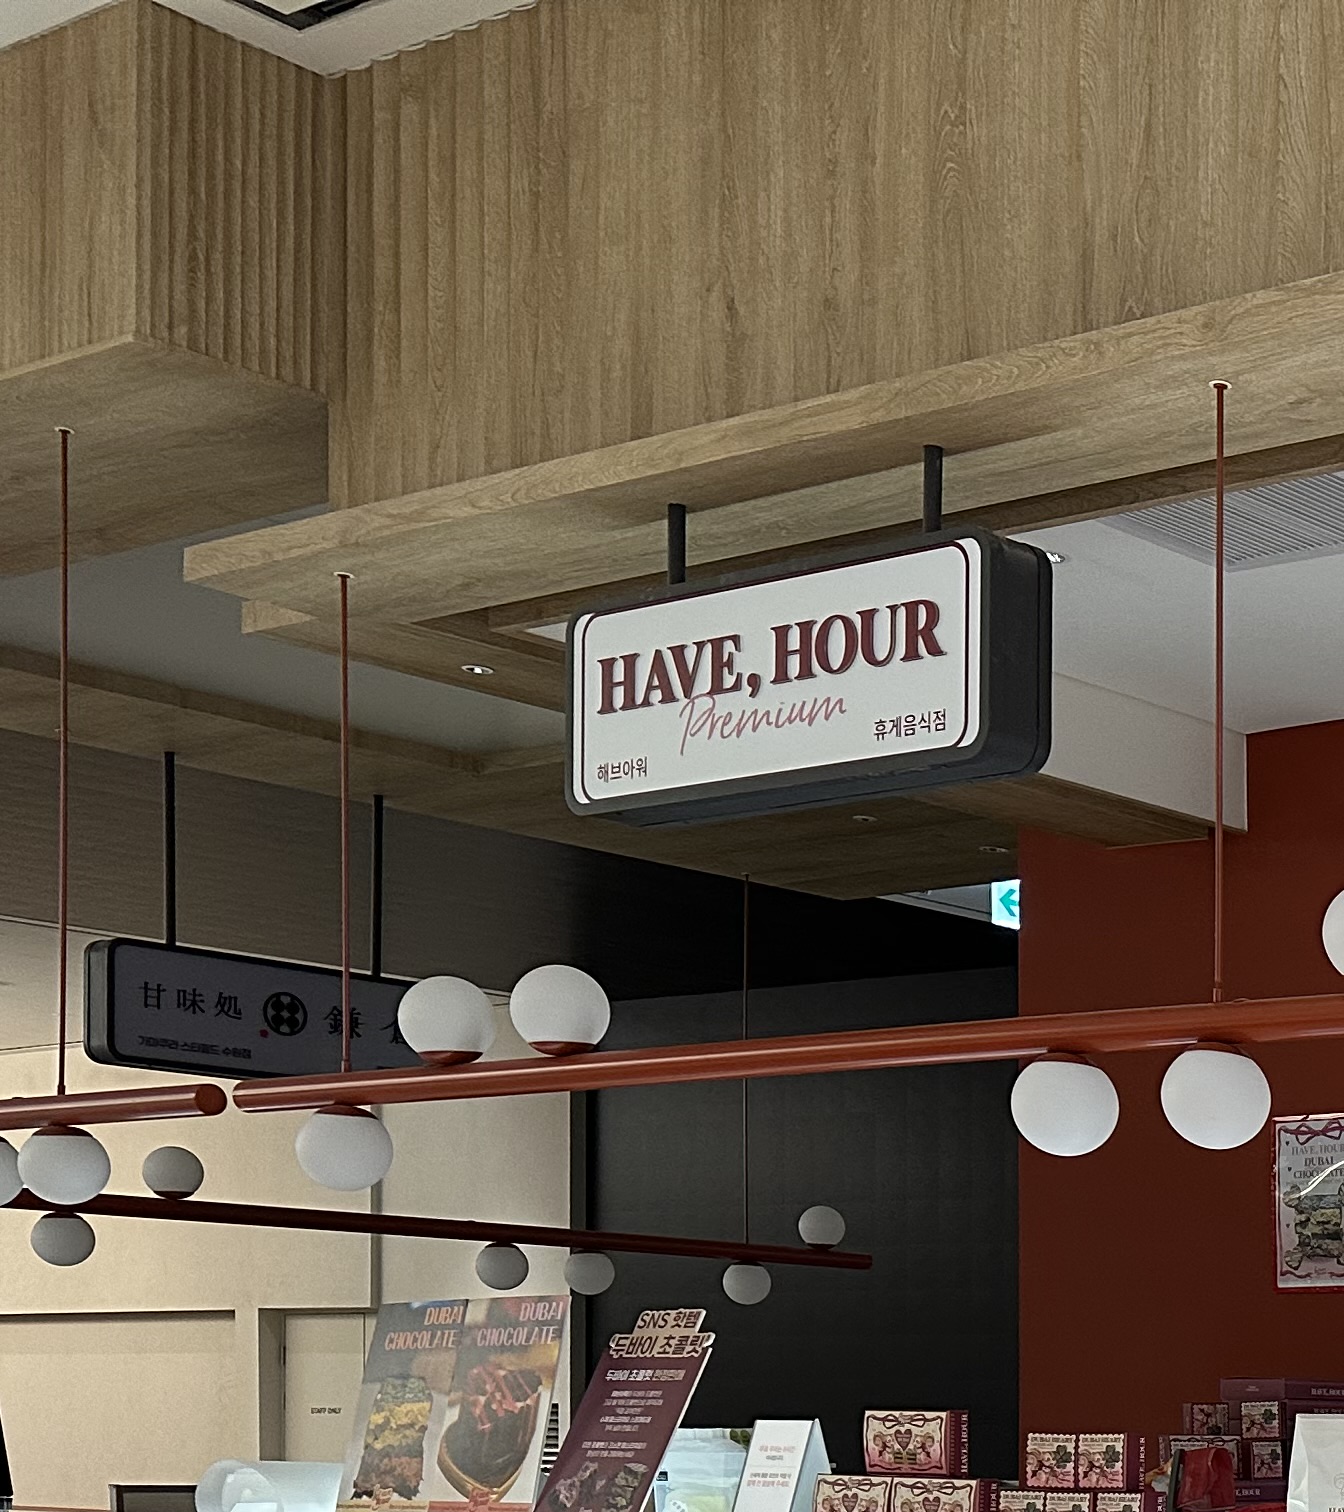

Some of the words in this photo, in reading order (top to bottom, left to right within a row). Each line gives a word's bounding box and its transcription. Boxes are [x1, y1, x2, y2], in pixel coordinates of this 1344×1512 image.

[597, 634, 761, 715] HAVE,
[770, 599, 947, 685] HOUR
[679, 694, 847, 756] Premium
[873, 709, 946, 741] 휴게음식점
[597, 756, 647, 783] 해브아워
[1293, 1168, 1344, 1179] CHOCATE
[424, 1305, 464, 1326] DUBAI
[519, 1301, 563, 1321] DUBAI
[637, 1312, 671, 1329] SNS
[670, 1311, 700, 1329] 핫템
[385, 1329, 457, 1351] CHOCOLATE
[477, 1326, 558, 1347] CHOCOLATE
